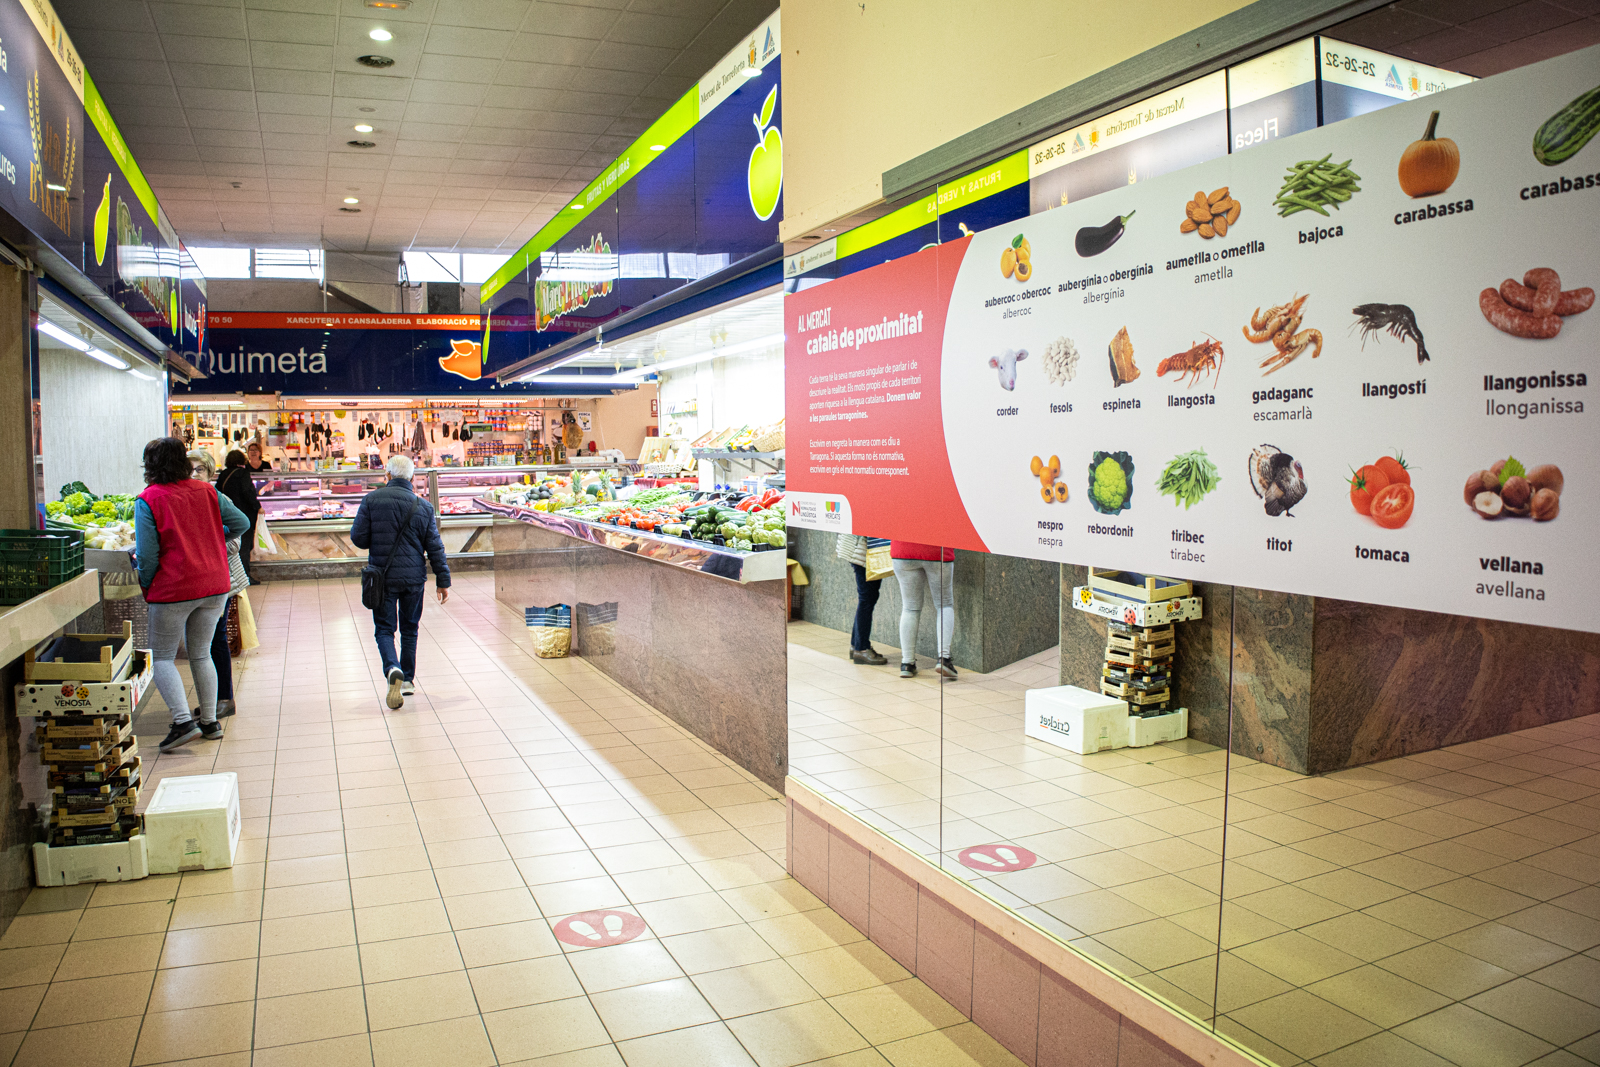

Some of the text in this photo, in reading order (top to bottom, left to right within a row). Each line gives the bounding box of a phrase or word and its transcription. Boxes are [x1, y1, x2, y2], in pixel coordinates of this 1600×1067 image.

[1394, 199, 1474, 225] carabassa
[1299, 225, 1344, 244] bajoca
[1166, 240, 1265, 271] aumetlla o ometlla
[1058, 263, 1154, 293] aubergínia o obergínia
[1194, 267, 1233, 284] ametlla
[985, 293, 1016, 308] aubercoc
[1022, 286, 1051, 300] obercoc
[1083, 286, 1125, 304] albergínia
[416, 317, 468, 325] ELABORACIÓ
[798, 307, 831, 334] AL MERCAT
[1003, 306, 1032, 320] albercoc
[806, 310, 923, 355] català de proximitat
[209, 346, 327, 374] uimeta
[1362, 378, 1426, 399] llangostí
[1483, 370, 1587, 393] llangonissa
[886, 392, 905, 402] Donem
[906, 390, 921, 400] valor
[1168, 393, 1215, 408] llangosta
[1252, 386, 1313, 404] gadaganc
[996, 406, 1019, 416] corder
[1050, 402, 1073, 414] fesols
[1102, 398, 1141, 412] espineta
[1253, 405, 1313, 422] escamarlà
[1486, 397, 1584, 420] llonganissa
[819, 412, 837, 423] paraules
[1038, 519, 1064, 532] nespro
[1088, 523, 1134, 538] rebordonit
[1038, 535, 1063, 548] nespra
[1171, 529, 1205, 544] tiribec
[1266, 537, 1293, 552] titot
[1170, 548, 1206, 563] tirabec
[1355, 544, 1410, 563] tomaca
[1479, 556, 1544, 576] vellana
[1476, 580, 1546, 601] avellana
